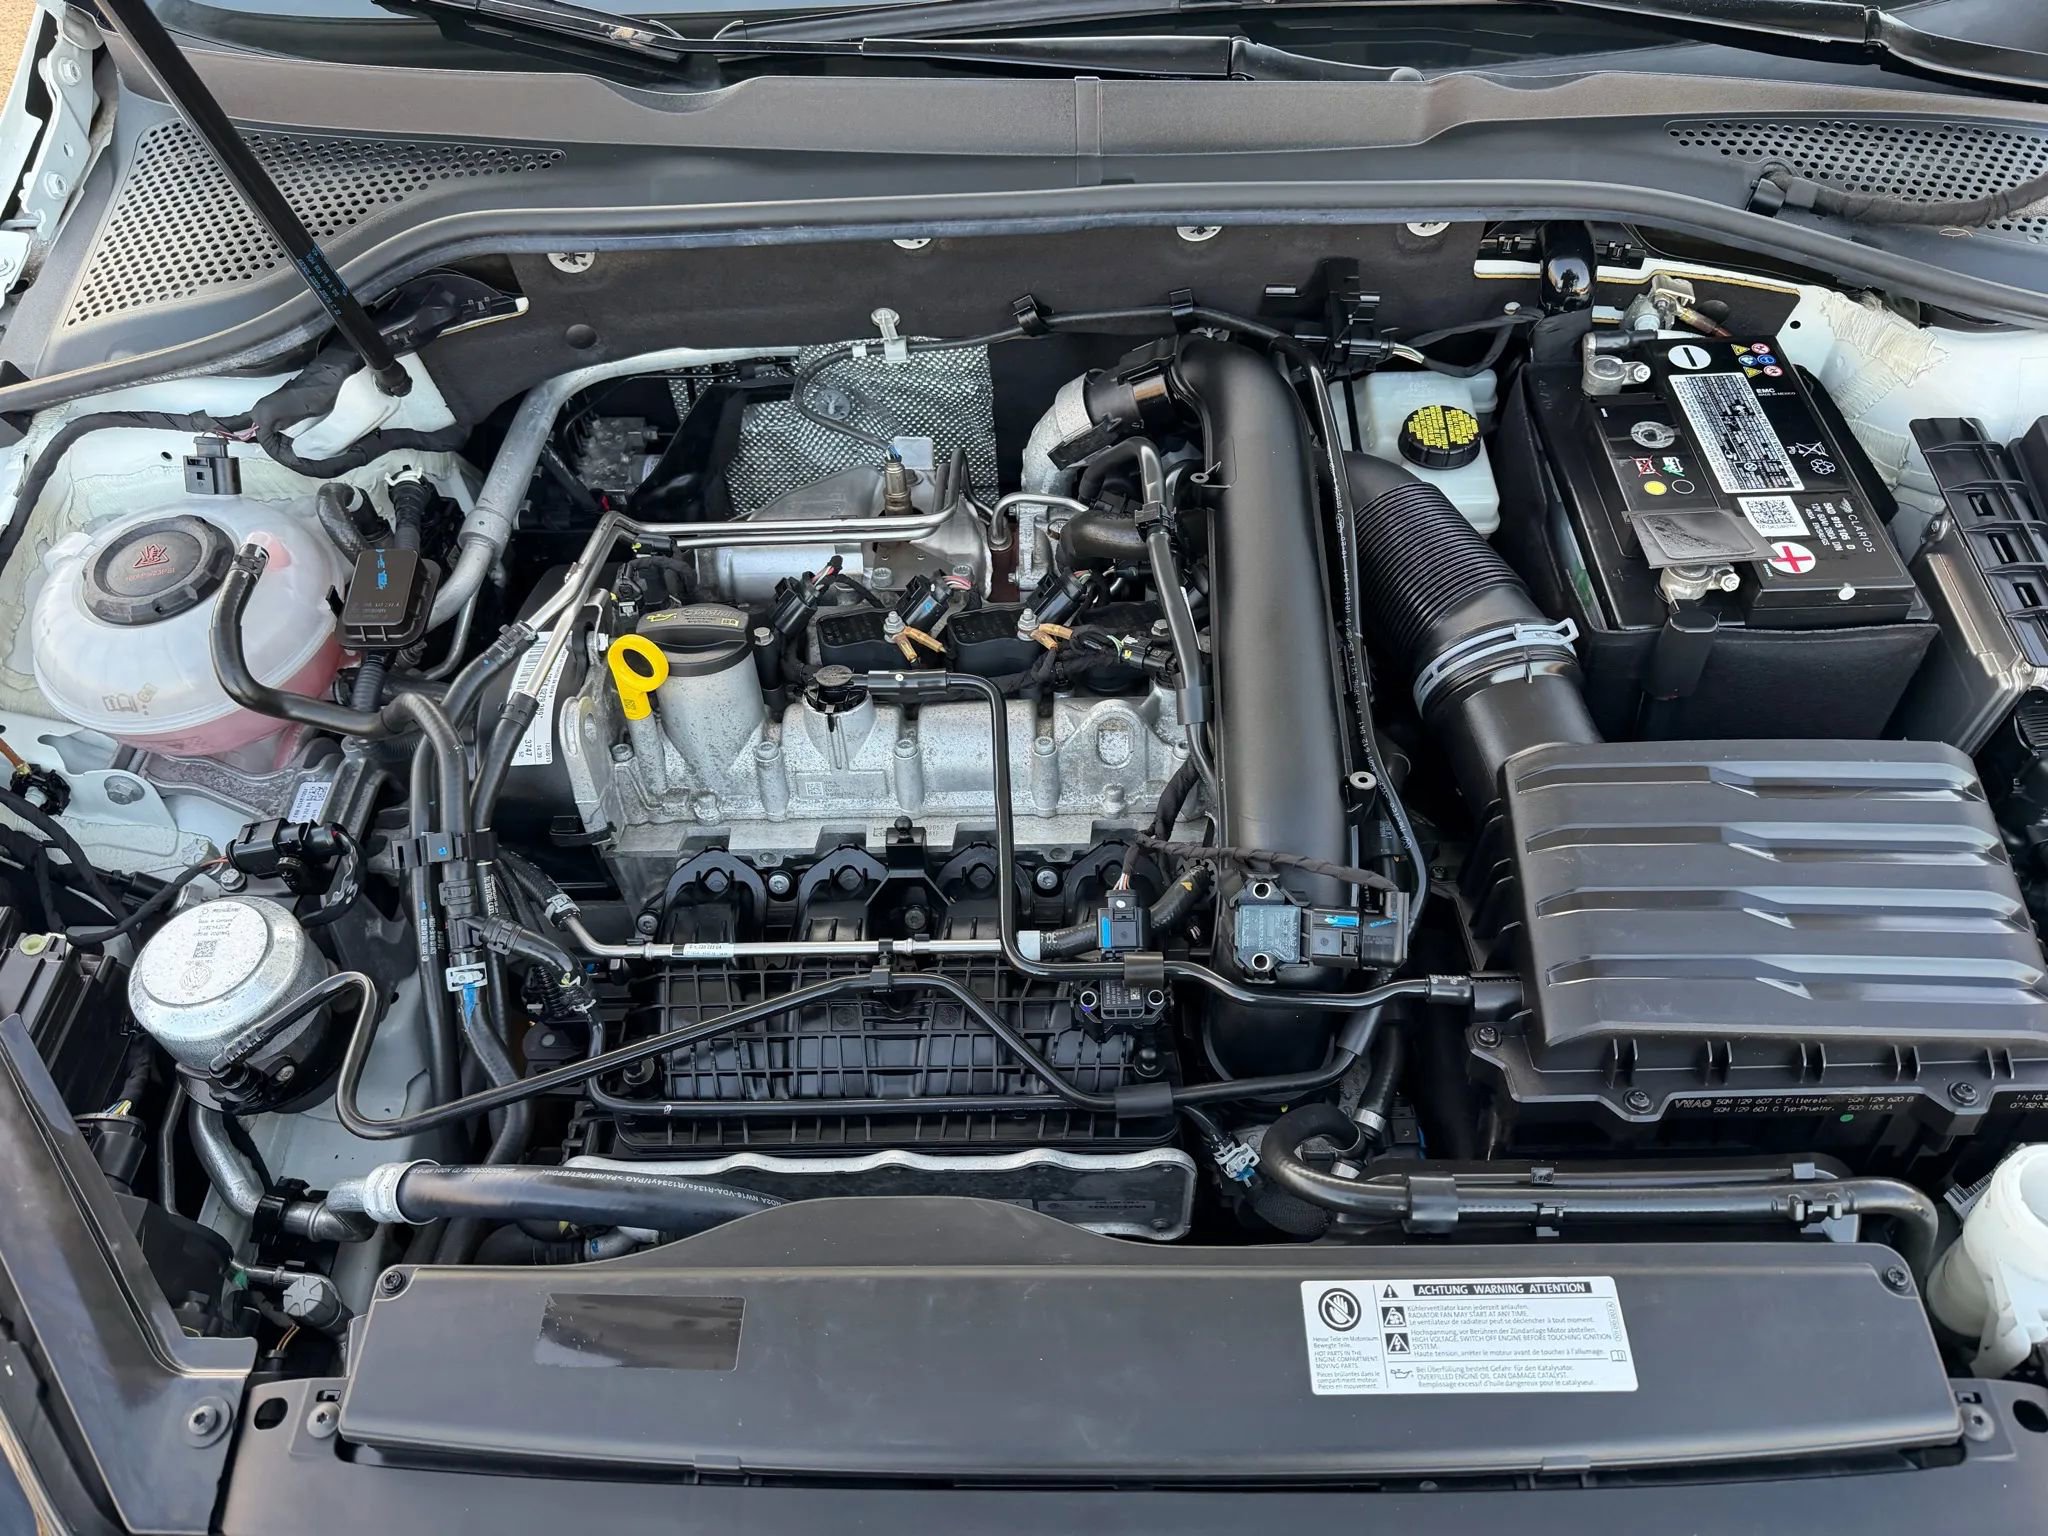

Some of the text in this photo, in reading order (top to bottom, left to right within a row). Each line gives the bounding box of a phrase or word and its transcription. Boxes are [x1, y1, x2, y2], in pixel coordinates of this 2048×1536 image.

[1831, 516, 1844, 531] 915
[1848, 514, 1876, 553] CLARIOS
[1418, 1283, 1586, 1295] ACHTUNG WARNING ATTENTION
[1473, 1303, 1499, 1311] jederzeit
[1489, 1318, 1503, 1326] peut
[1510, 1327, 1546, 1335] Zündanlage
[1418, 1381, 1456, 1389] Remplissage
[1505, 1380, 1538, 1388] dangereux
